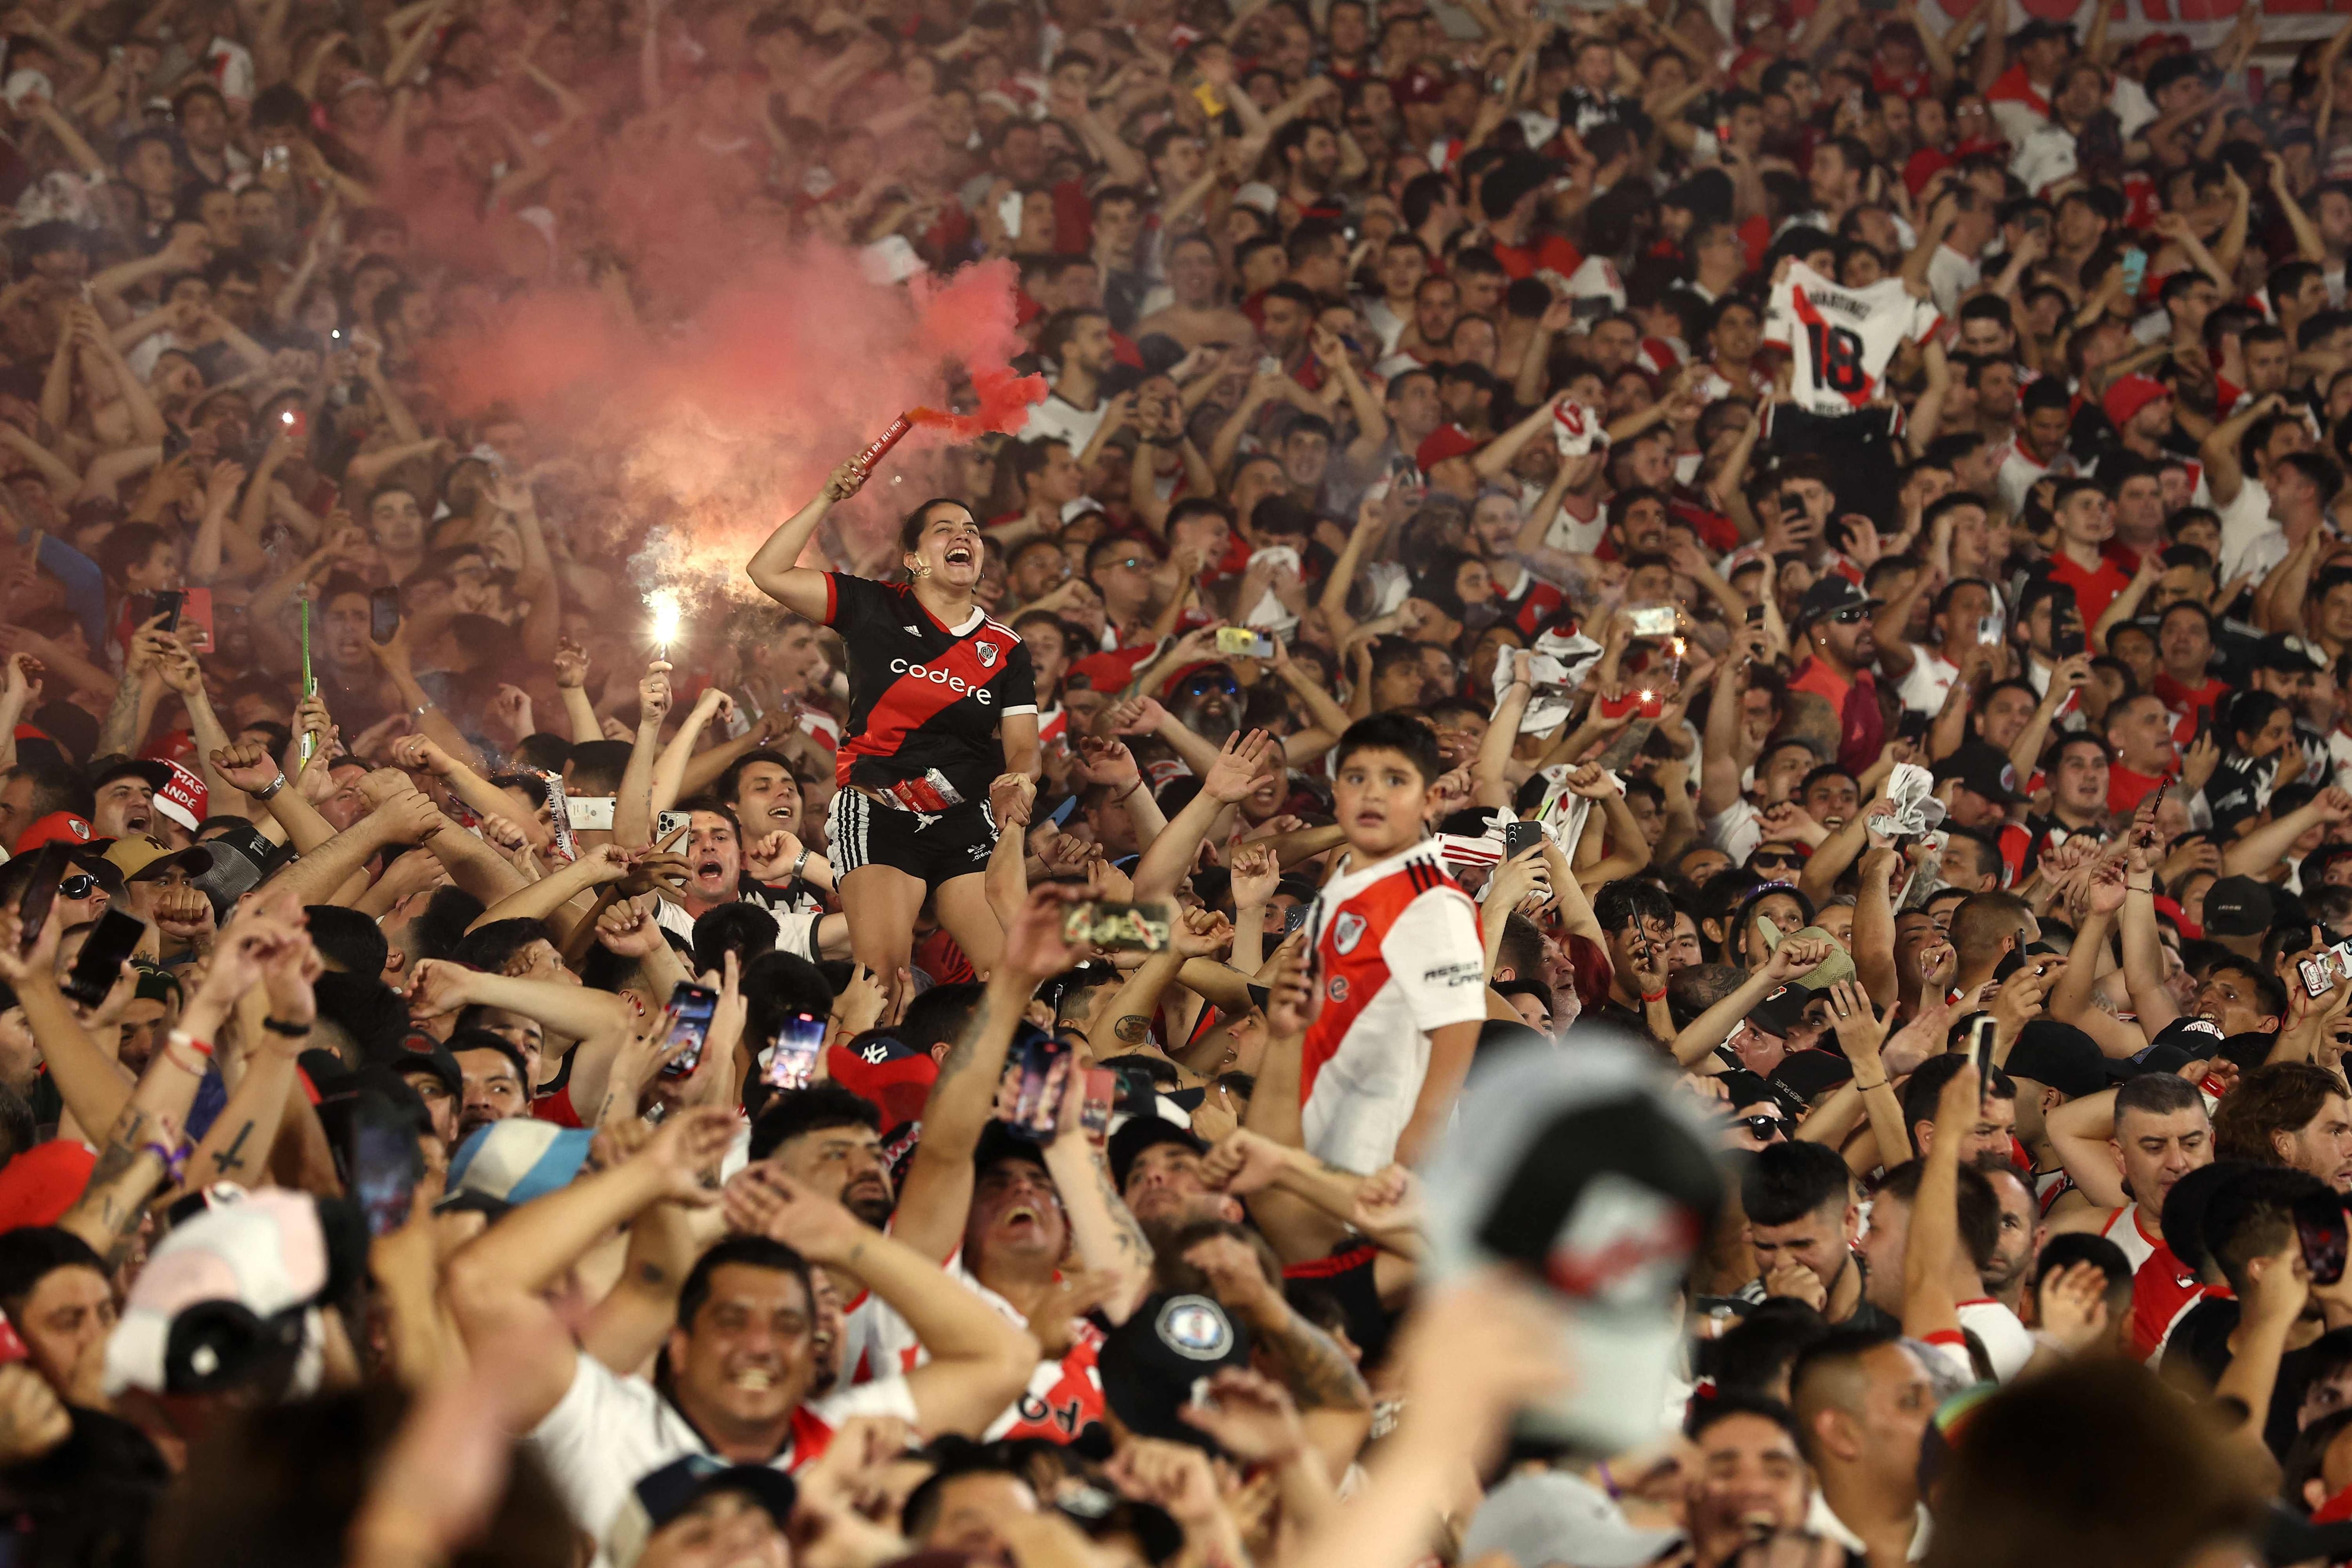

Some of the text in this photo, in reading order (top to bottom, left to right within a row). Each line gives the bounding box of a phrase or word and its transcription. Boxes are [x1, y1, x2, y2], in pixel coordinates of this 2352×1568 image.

[1808, 322, 1864, 394] 18
[881, 420, 901, 443] HUMO
[890, 658, 992, 705] codere
[173, 770, 204, 795] MAS
[971, 850, 992, 862] adidas
